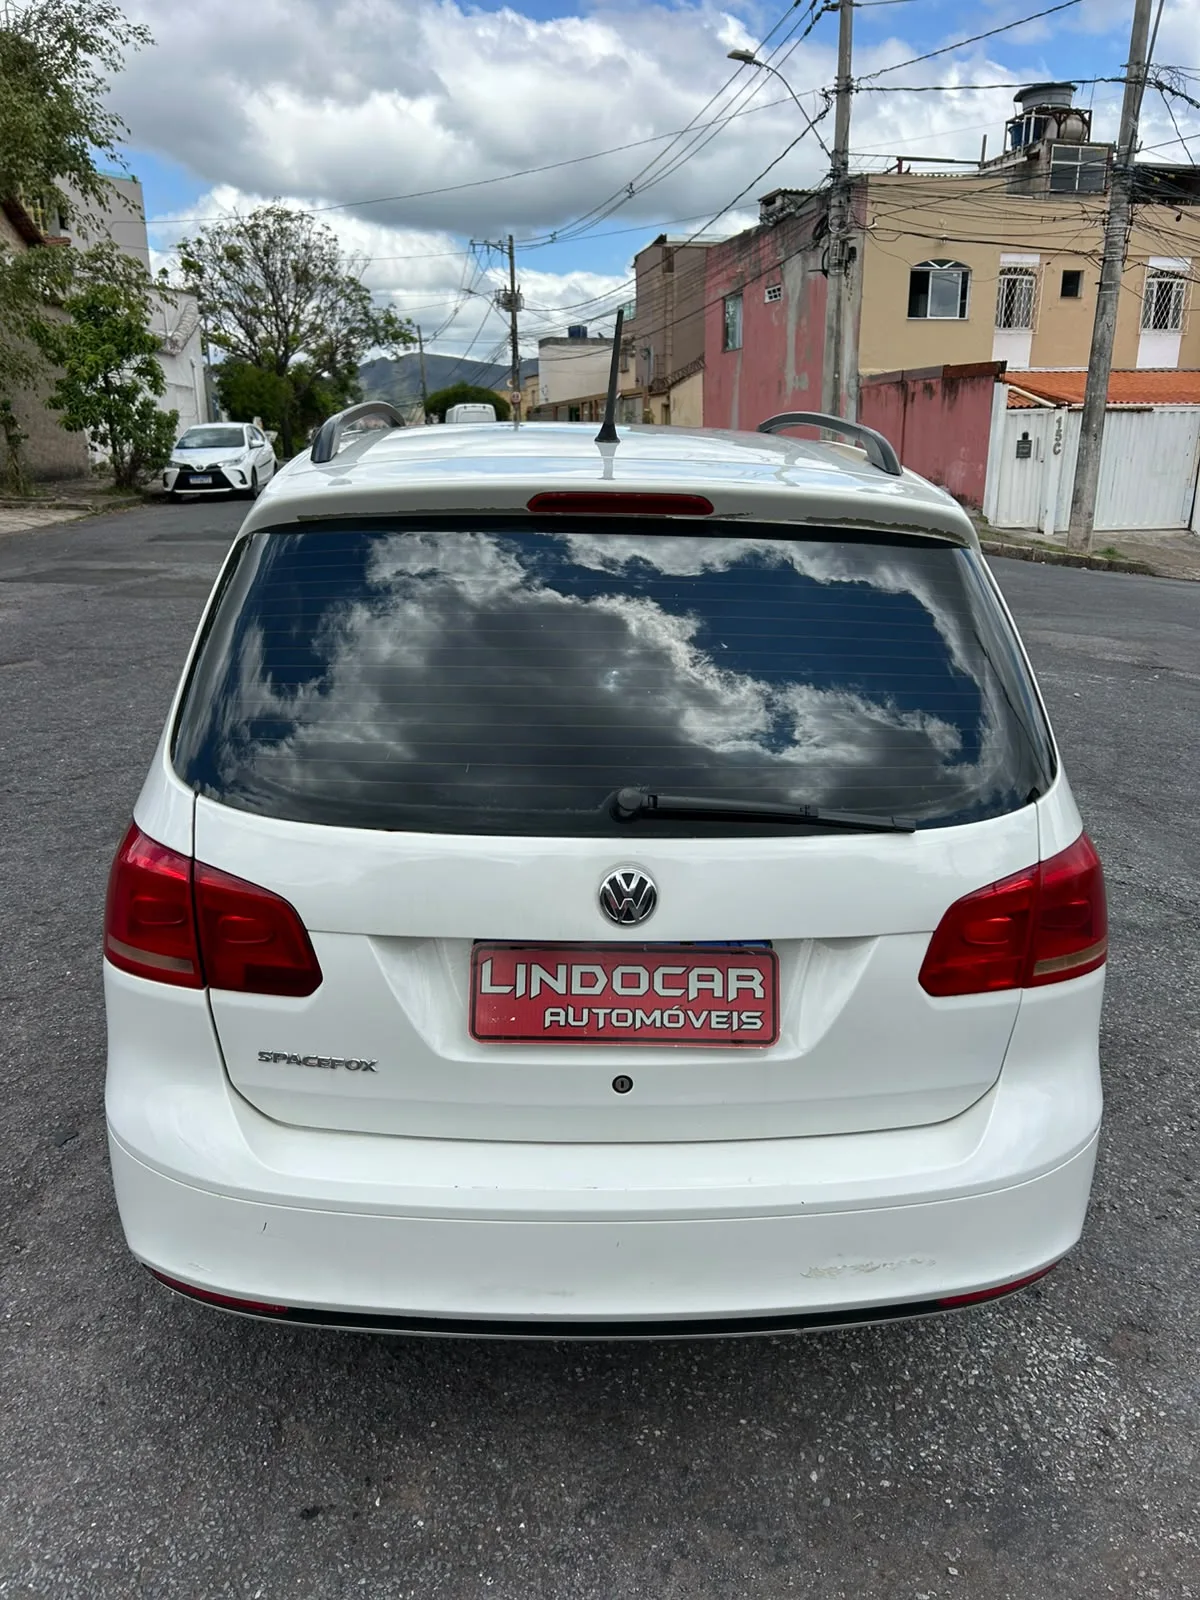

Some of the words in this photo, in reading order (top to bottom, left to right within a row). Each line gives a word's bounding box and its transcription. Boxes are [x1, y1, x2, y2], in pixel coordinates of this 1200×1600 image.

[600, 868, 657, 925] VW
[480, 958, 766, 1003] LINDOCAR
[543, 1004, 764, 1032] AUTOMÓVEIS
[258, 1051, 378, 1073] SPACEFOX
